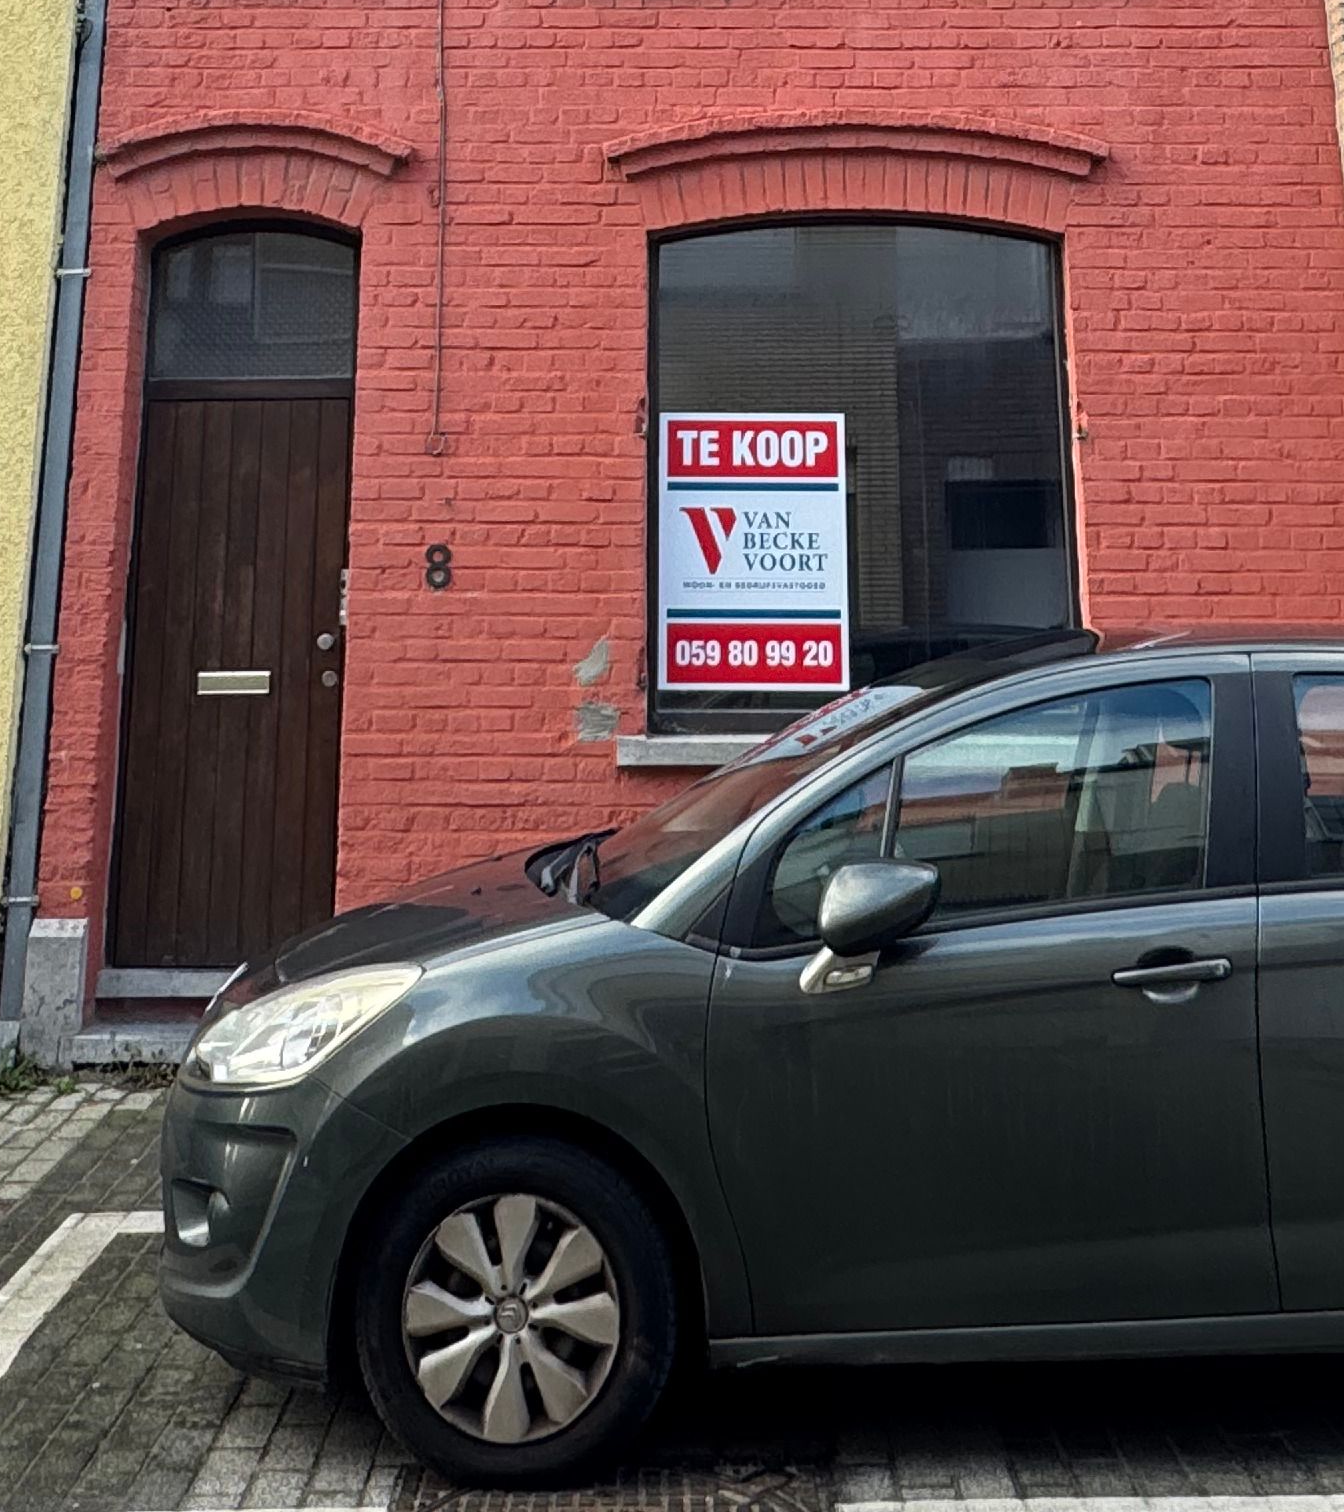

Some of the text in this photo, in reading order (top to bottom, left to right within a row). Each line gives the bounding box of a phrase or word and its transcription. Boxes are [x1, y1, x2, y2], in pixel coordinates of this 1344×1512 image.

[676, 430, 829, 468] TE KOOP
[743, 511, 792, 530] VAN
[742, 532, 820, 550] BECKE
[425, 543, 453, 590] 8
[743, 552, 829, 572] VOORT
[675, 639, 834, 667] 059 80 99 20
